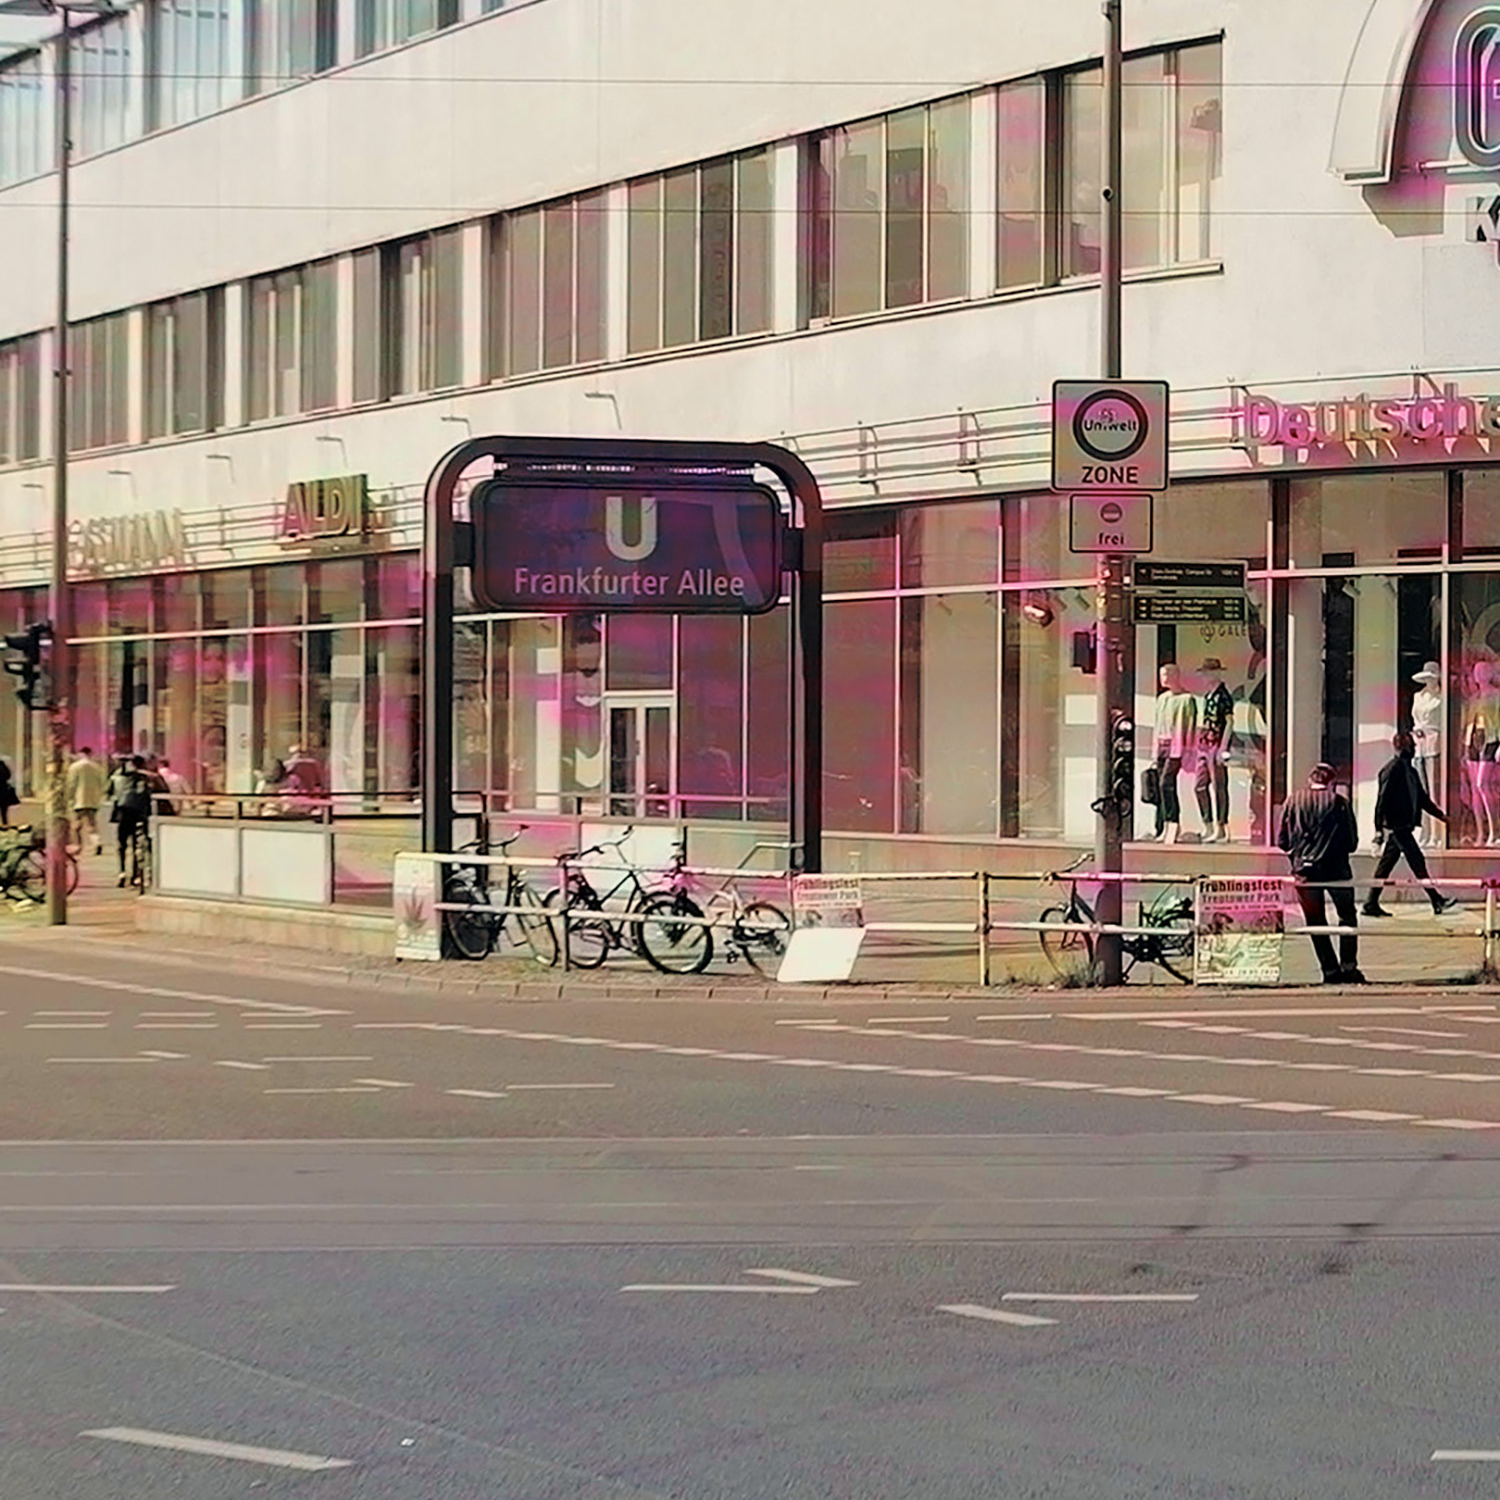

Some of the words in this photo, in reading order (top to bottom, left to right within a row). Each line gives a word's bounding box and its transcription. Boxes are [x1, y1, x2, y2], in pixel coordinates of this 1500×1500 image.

[1081, 466, 1139, 484] ZONE
[284, 474, 367, 536] ALDI
[606, 496, 658, 561] U
[1098, 532, 1125, 545] frei
[514, 567, 669, 596] Frankfurter
[677, 568, 745, 596] Allee
